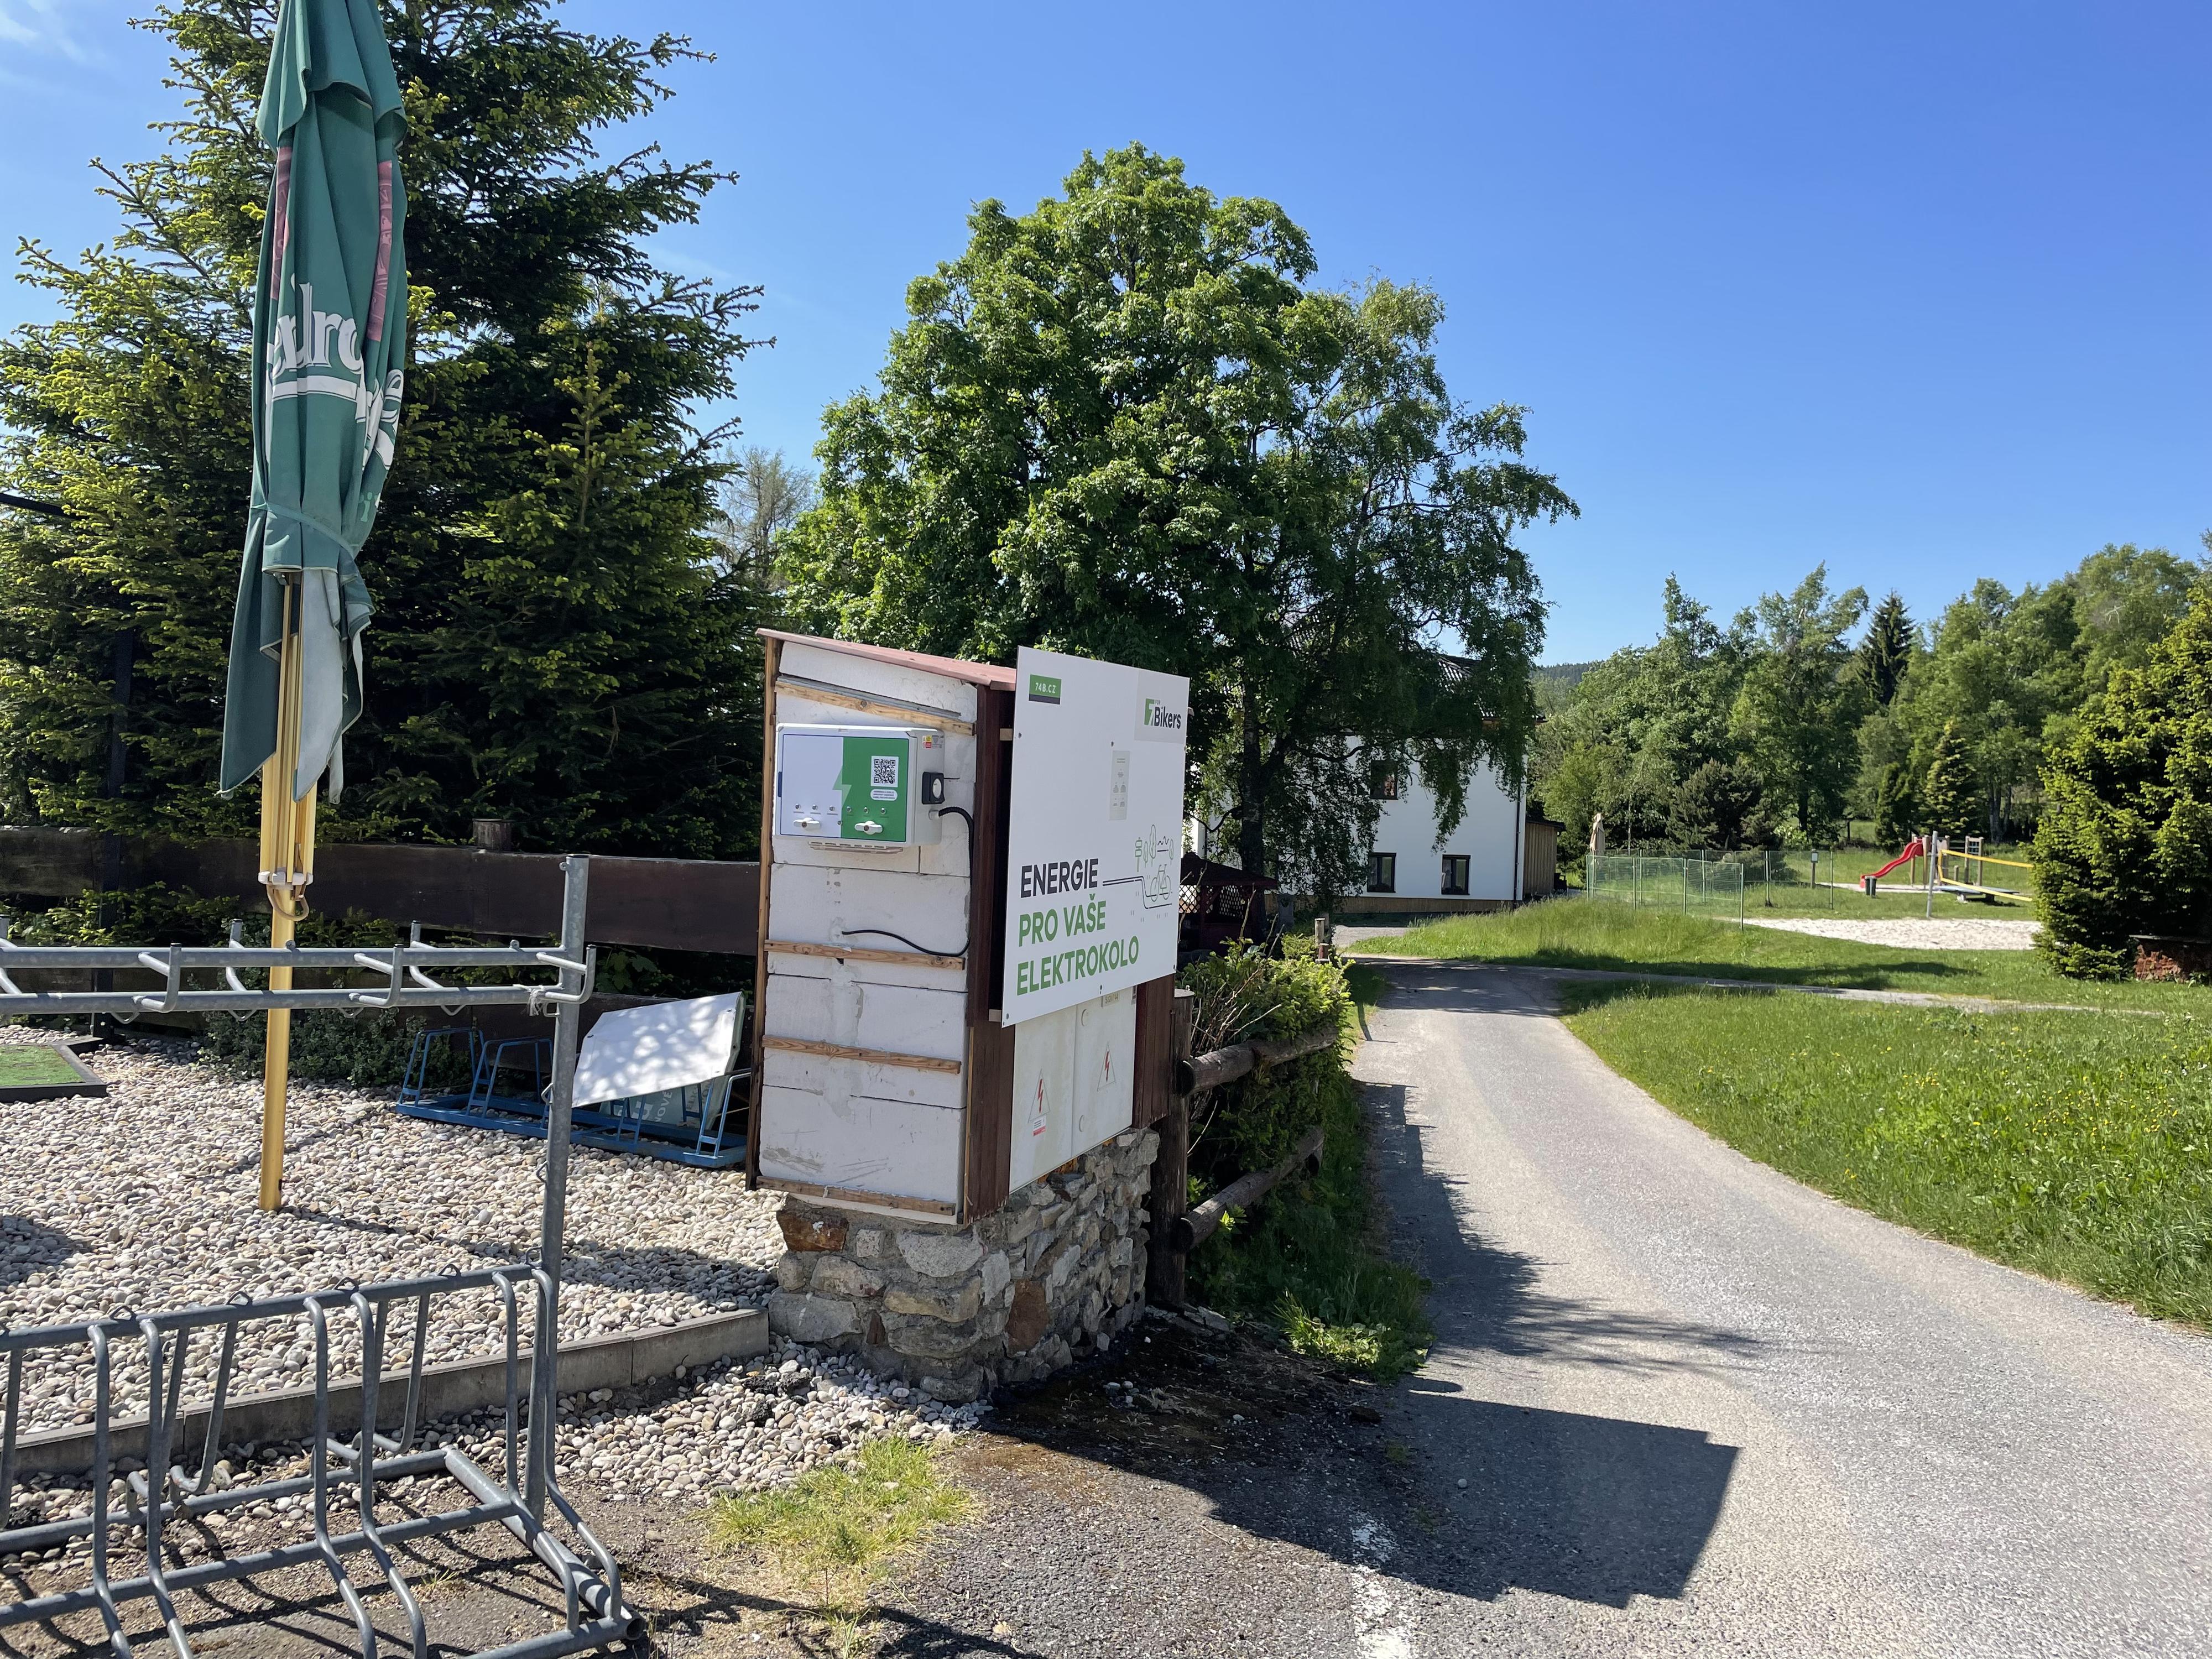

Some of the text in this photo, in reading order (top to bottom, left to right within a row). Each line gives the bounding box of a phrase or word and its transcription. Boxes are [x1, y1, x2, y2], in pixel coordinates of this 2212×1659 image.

[1035, 682, 1056, 693] 74B.CZ
[1154, 706, 1181, 729] Bikers
[1020, 858, 1099, 898] ENERGIE
[1019, 894, 1107, 947] PRO VAŠE
[1017, 936, 1139, 996] ELEKTROKOLO
